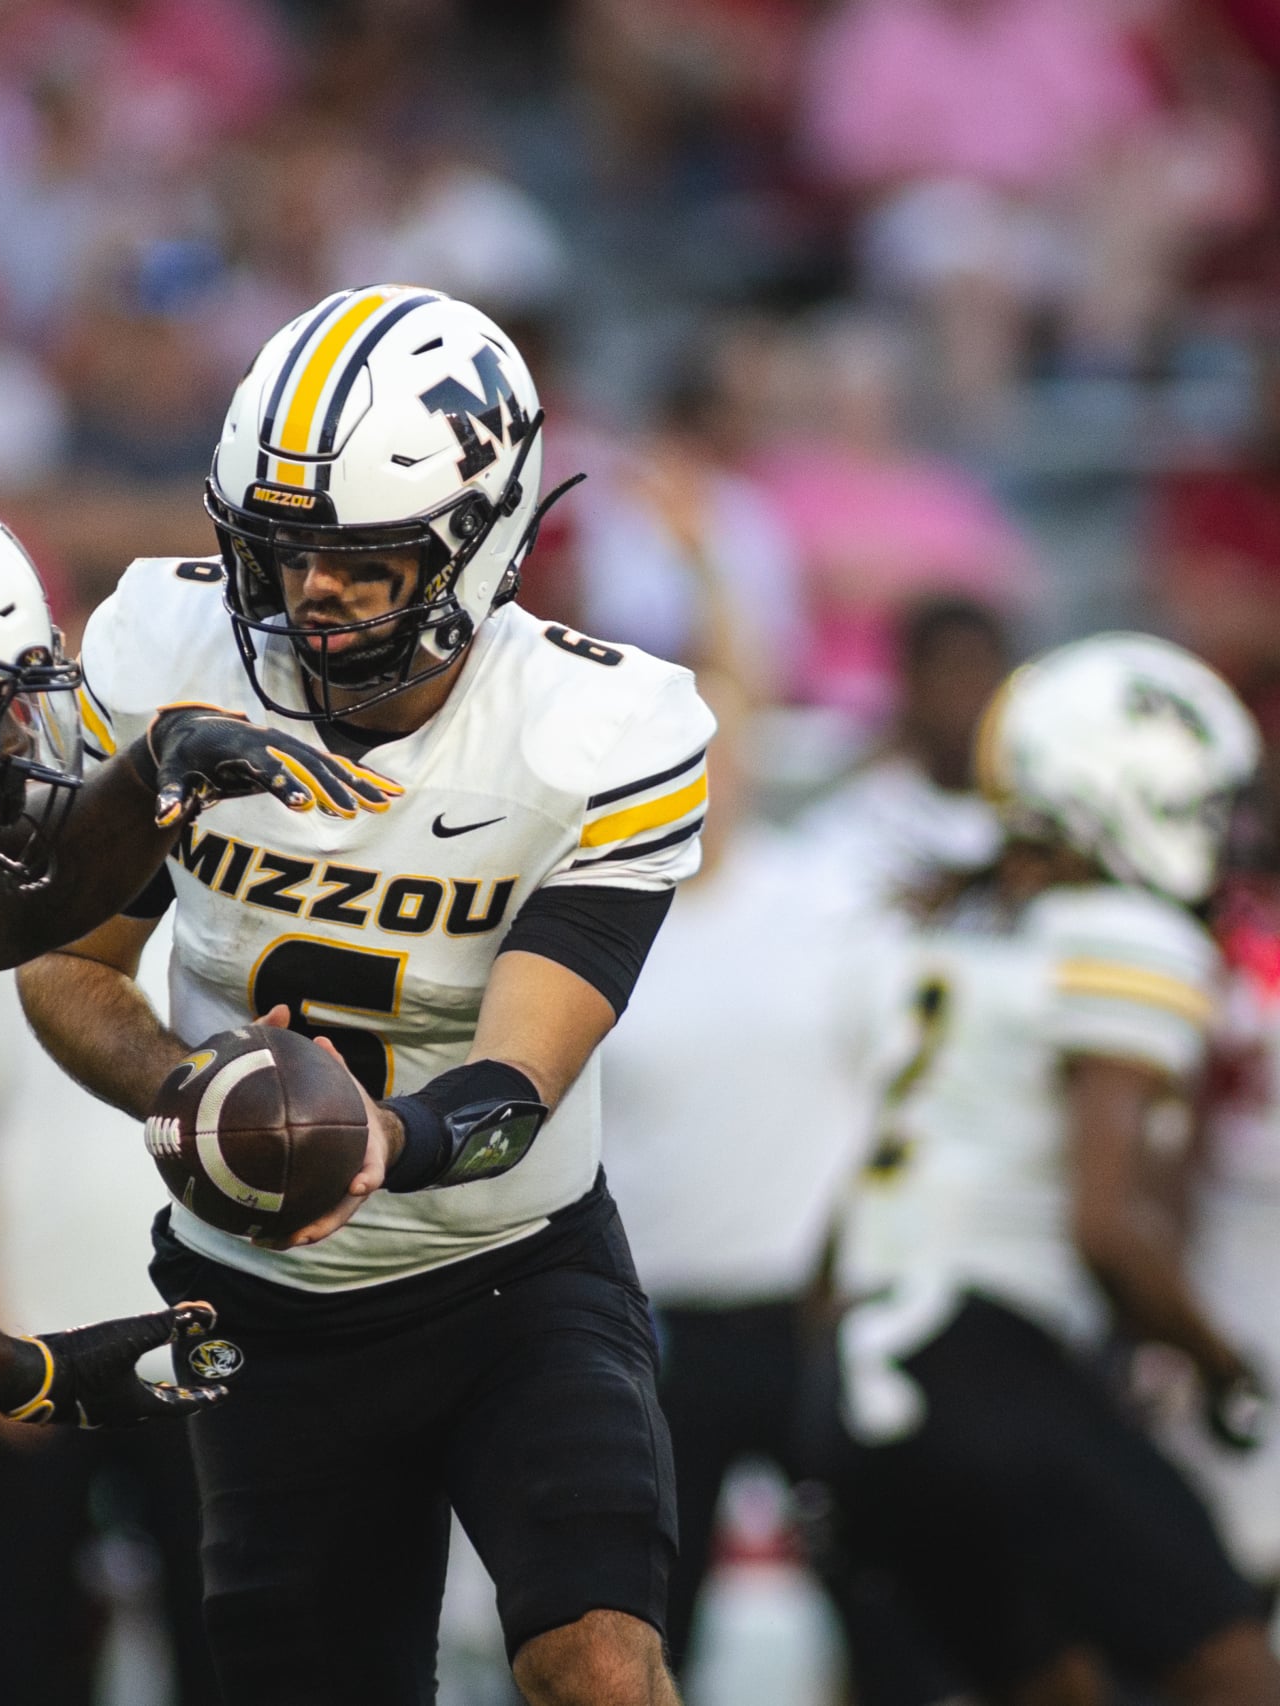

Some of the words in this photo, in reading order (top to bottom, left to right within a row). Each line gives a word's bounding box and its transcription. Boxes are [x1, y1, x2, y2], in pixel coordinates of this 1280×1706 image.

[417, 343, 531, 484] M
[252, 486, 317, 509] MIZZOU
[541, 623, 626, 668] 6
[175, 822, 520, 938] MIZZOU
